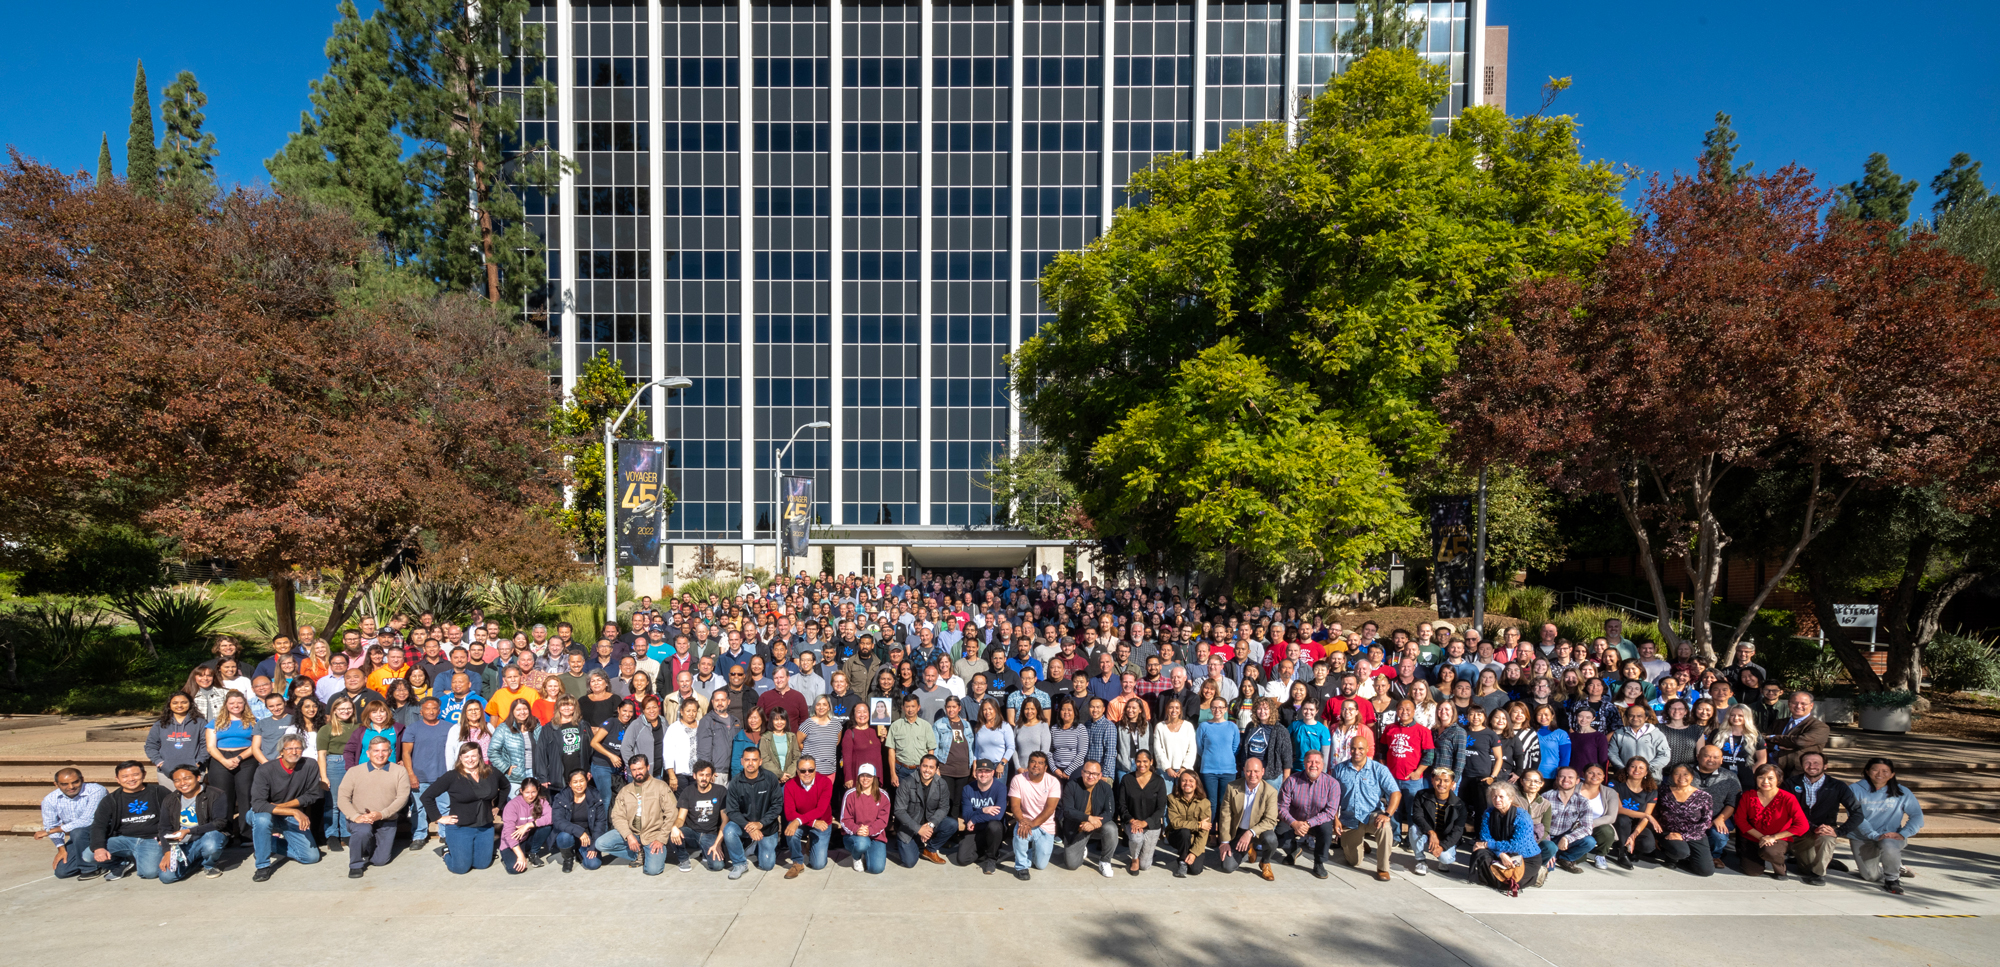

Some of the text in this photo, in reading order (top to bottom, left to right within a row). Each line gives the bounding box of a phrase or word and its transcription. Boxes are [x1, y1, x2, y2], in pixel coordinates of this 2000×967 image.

[625, 471, 658, 482] VOYAGER
[622, 482, 657, 509] 45
[787, 495, 808, 504] VOYAGER
[784, 502, 807, 520] 45
[638, 527, 654, 535] 2022
[1438, 524, 1467, 536] VOYAGER
[1437, 536, 1468, 562] 45
[1454, 579, 1468, 587] 2022
[971, 797, 994, 807] NASA
[122, 814, 156, 822] EUROPA
